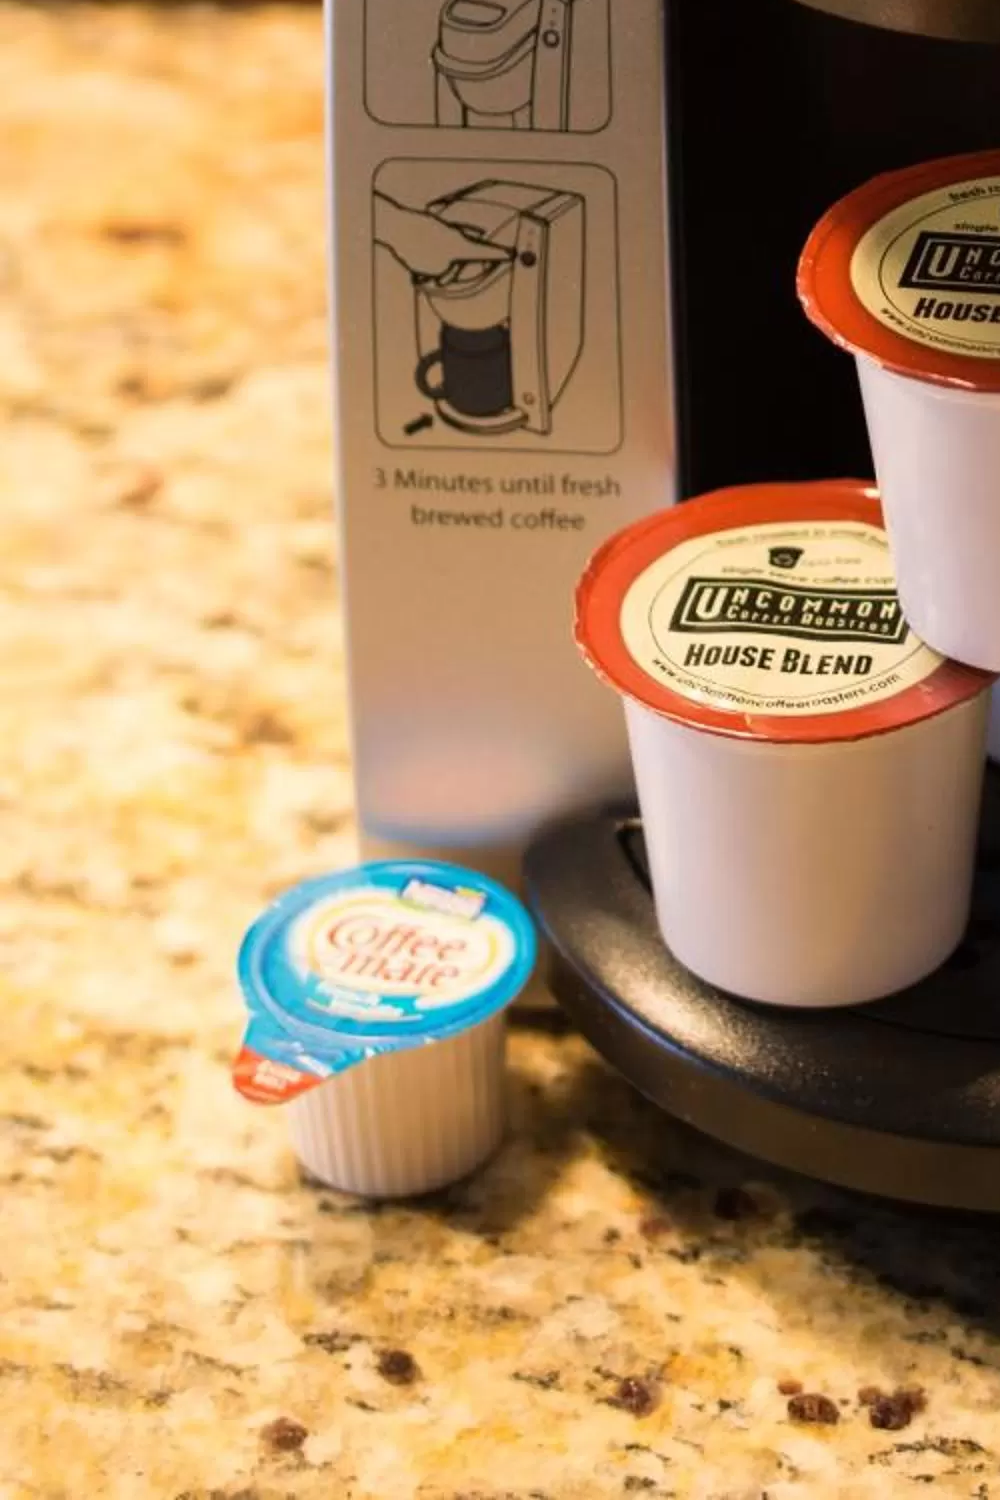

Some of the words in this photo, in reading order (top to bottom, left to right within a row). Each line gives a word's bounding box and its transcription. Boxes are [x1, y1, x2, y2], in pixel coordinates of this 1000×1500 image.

[374, 467, 387, 489] 3
[393, 469, 493, 494] Minutes
[499, 474, 554, 495] until
[561, 473, 621, 498] fresh
[410, 504, 504, 529] brewed
[510, 507, 586, 531] coffee
[683, 643, 775, 671] HOUSE
[780, 648, 873, 676] BLEND
[327, 913, 468, 961] Coffee
